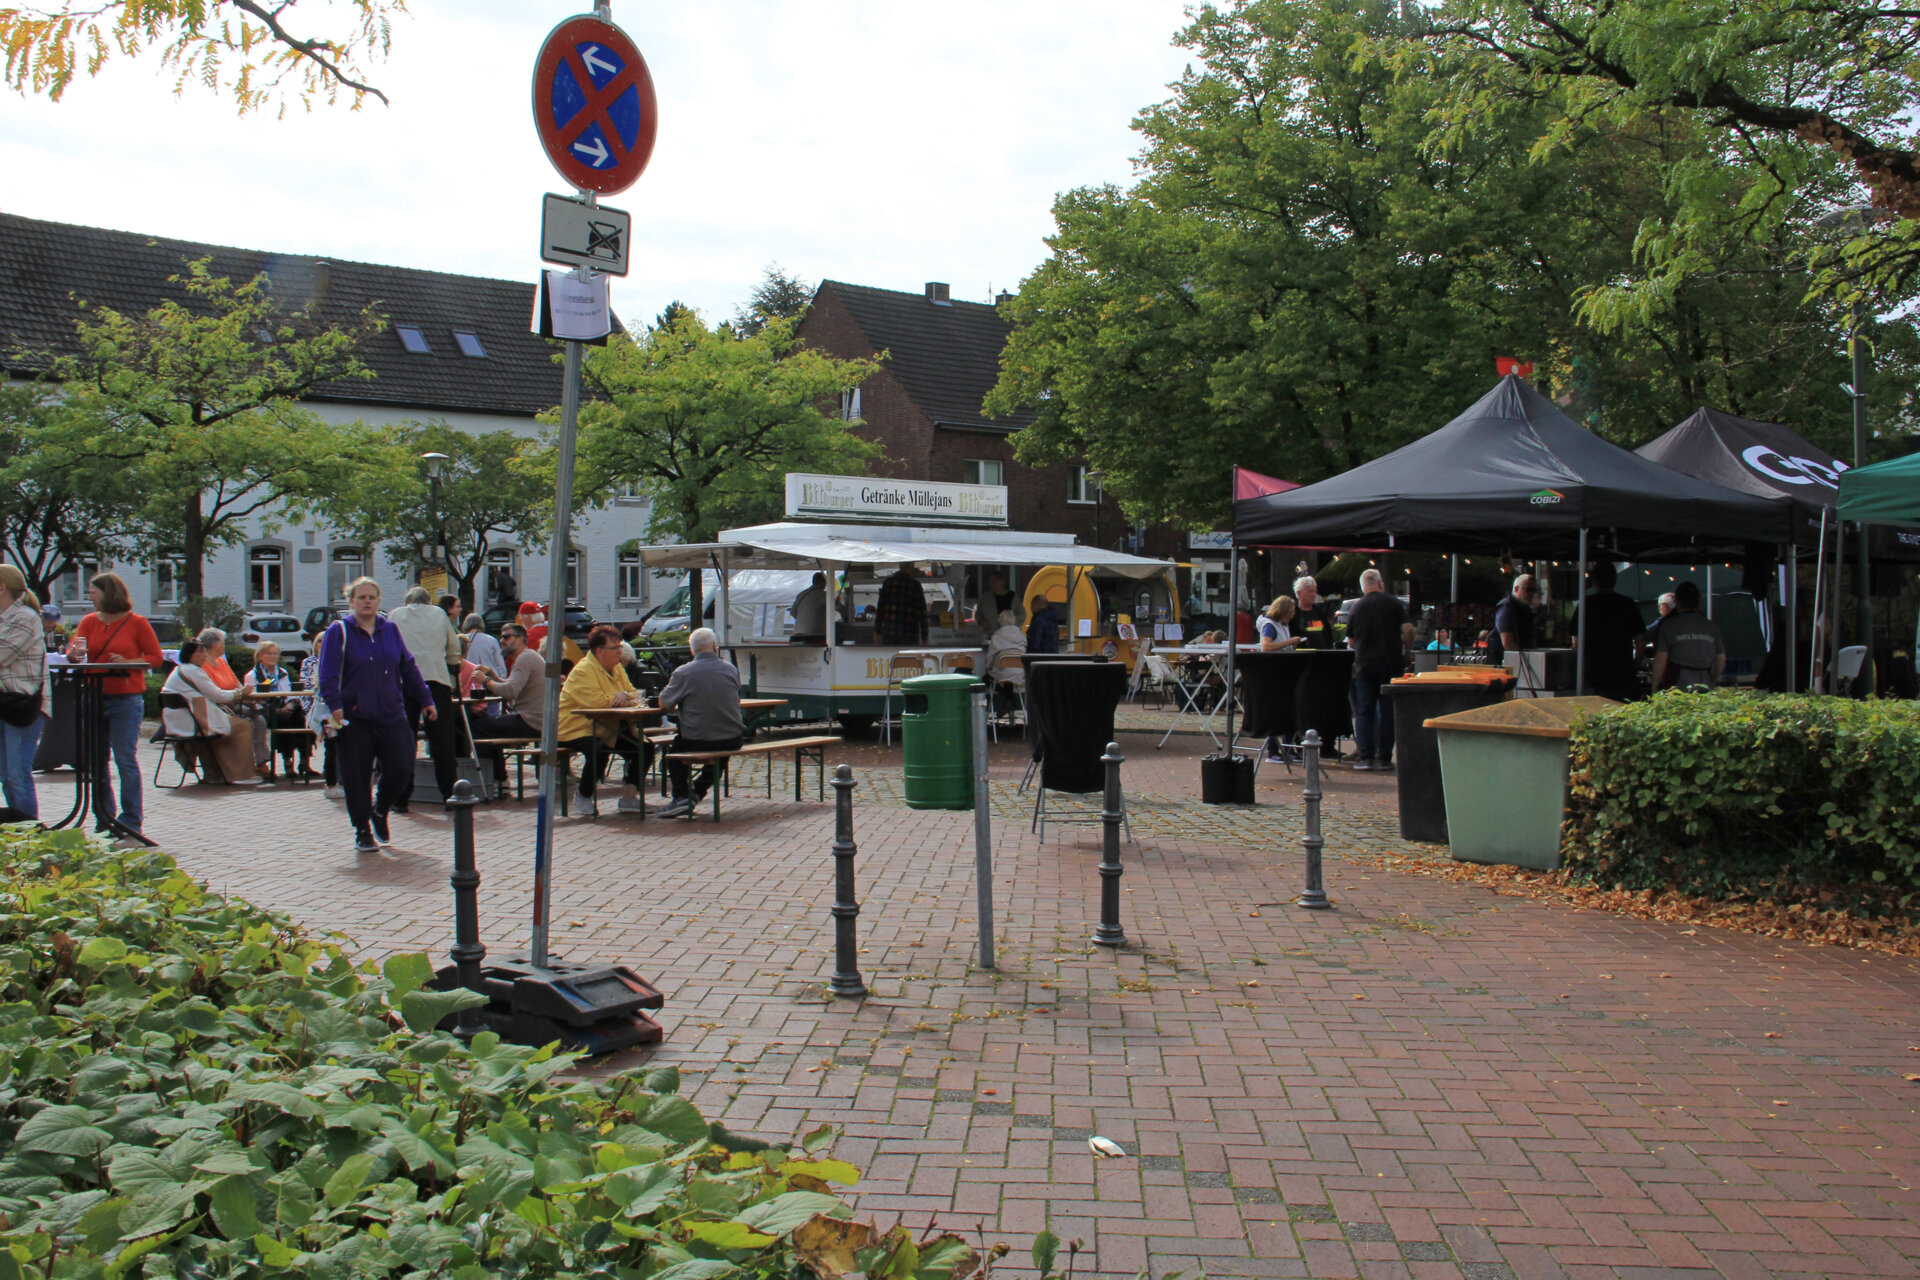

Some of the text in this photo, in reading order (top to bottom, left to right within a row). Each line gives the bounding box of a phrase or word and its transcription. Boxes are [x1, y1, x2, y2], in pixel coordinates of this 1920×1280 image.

[801, 482, 855, 508] Bitburger
[861, 486, 953, 511] Getränke Müllejans
[1530, 496, 1561, 505] COBIZI
